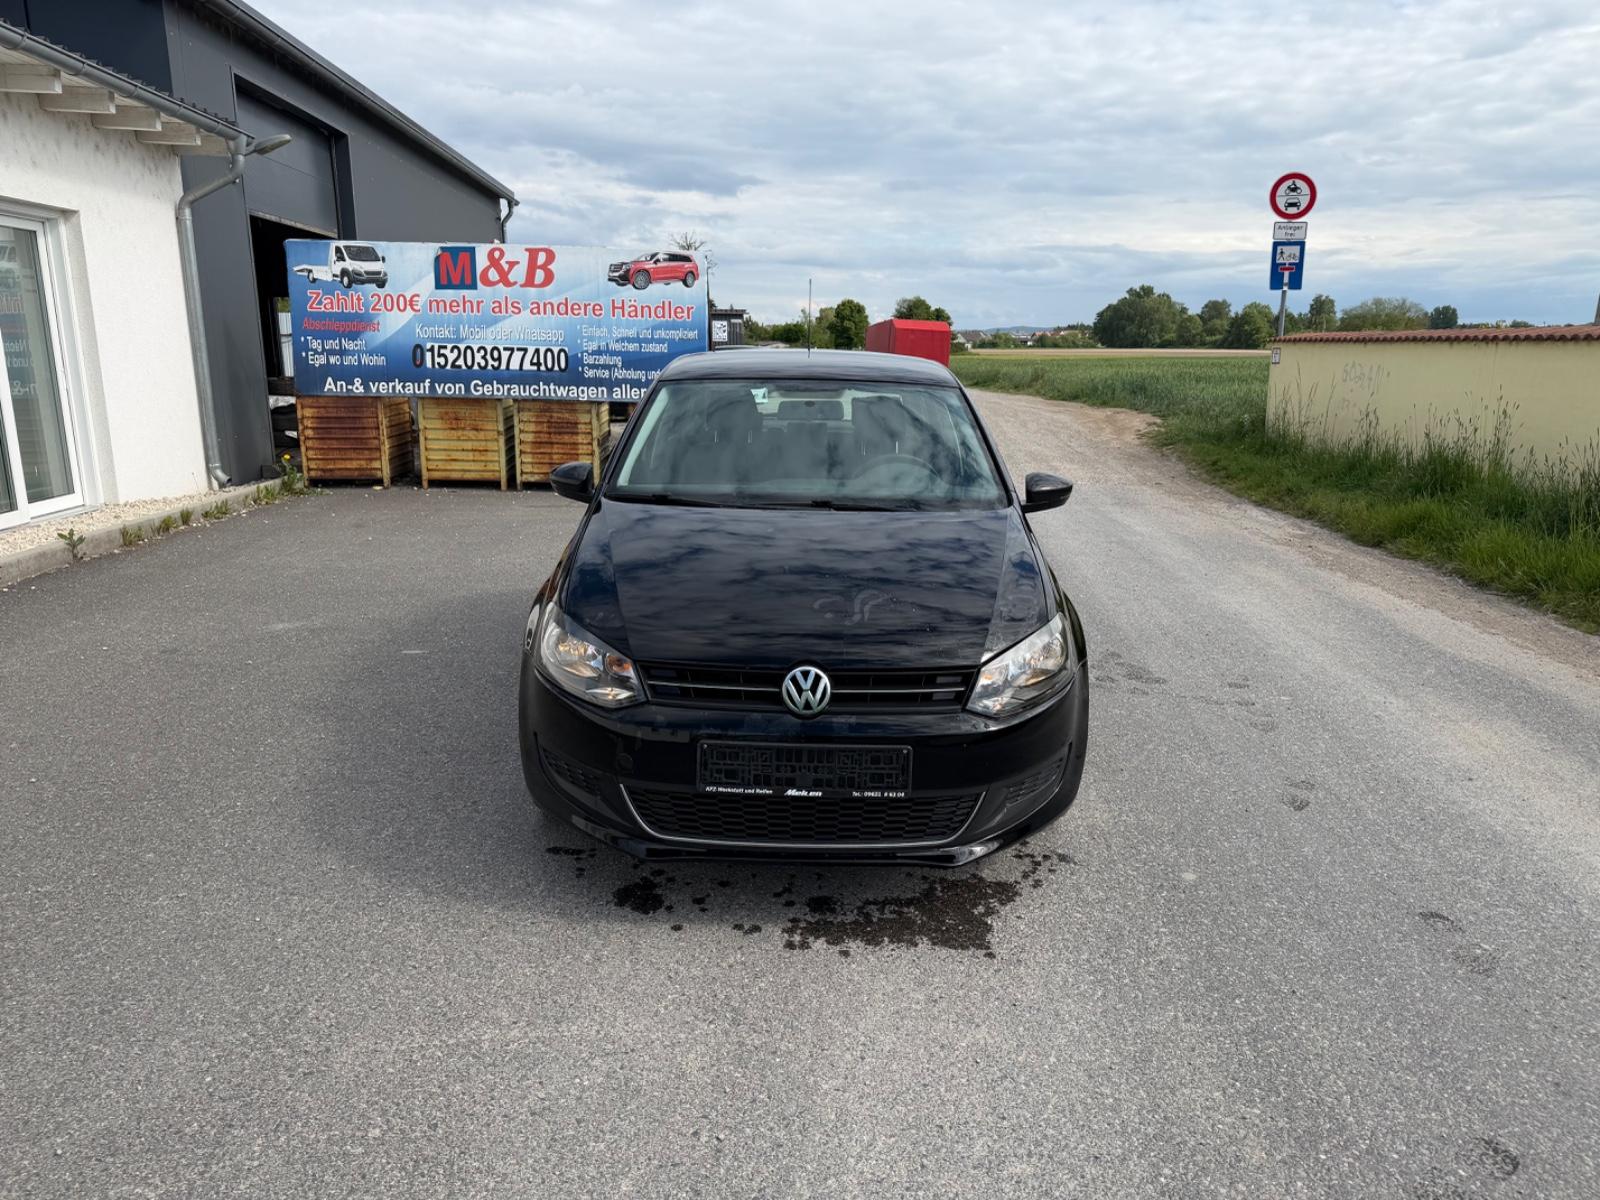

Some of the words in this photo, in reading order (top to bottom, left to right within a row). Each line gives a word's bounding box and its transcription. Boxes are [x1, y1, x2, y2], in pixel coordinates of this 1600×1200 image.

[307, 290, 364, 313] Zahlt
[369, 293, 421, 314] 200€
[428, 295, 484, 314] mehr
[491, 296, 522, 316] als
[529, 297, 604, 318] andere
[610, 298, 695, 321] Händler
[303, 317, 380, 333] Abschleppdienst
[415, 325, 457, 339] Kontakt:
[459, 325, 486, 340] Mobil
[489, 326, 513, 340] oder
[516, 327, 565, 344] Whatsapp
[612, 326, 637, 338] Schnell
[639, 327, 652, 338] und
[653, 328, 698, 341] unkompliziert
[307, 336, 322, 352] Tag
[325, 337, 340, 350] und
[342, 338, 366, 350] Nacht
[582, 339, 598, 353] Egal
[600, 341, 607, 350] in
[608, 341, 640, 352] Welchem
[641, 342, 668, 353] zustand
[308, 352, 327, 367] Egal
[329, 355, 341, 365] wo
[343, 353, 358, 365] und
[360, 354, 386, 366] Wohin
[412, 344, 569, 372] 015203977400
[583, 353, 622, 367] Barzahlung
[583, 367, 610, 379] Service
[611, 367, 646, 382] (Abholung
[324, 377, 365, 393] An-&
[369, 378, 431, 394] verkauf
[435, 382, 465, 395] von
[470, 381, 608, 400] Gebrauchtwagen
[782, 665, 831, 715] VW
